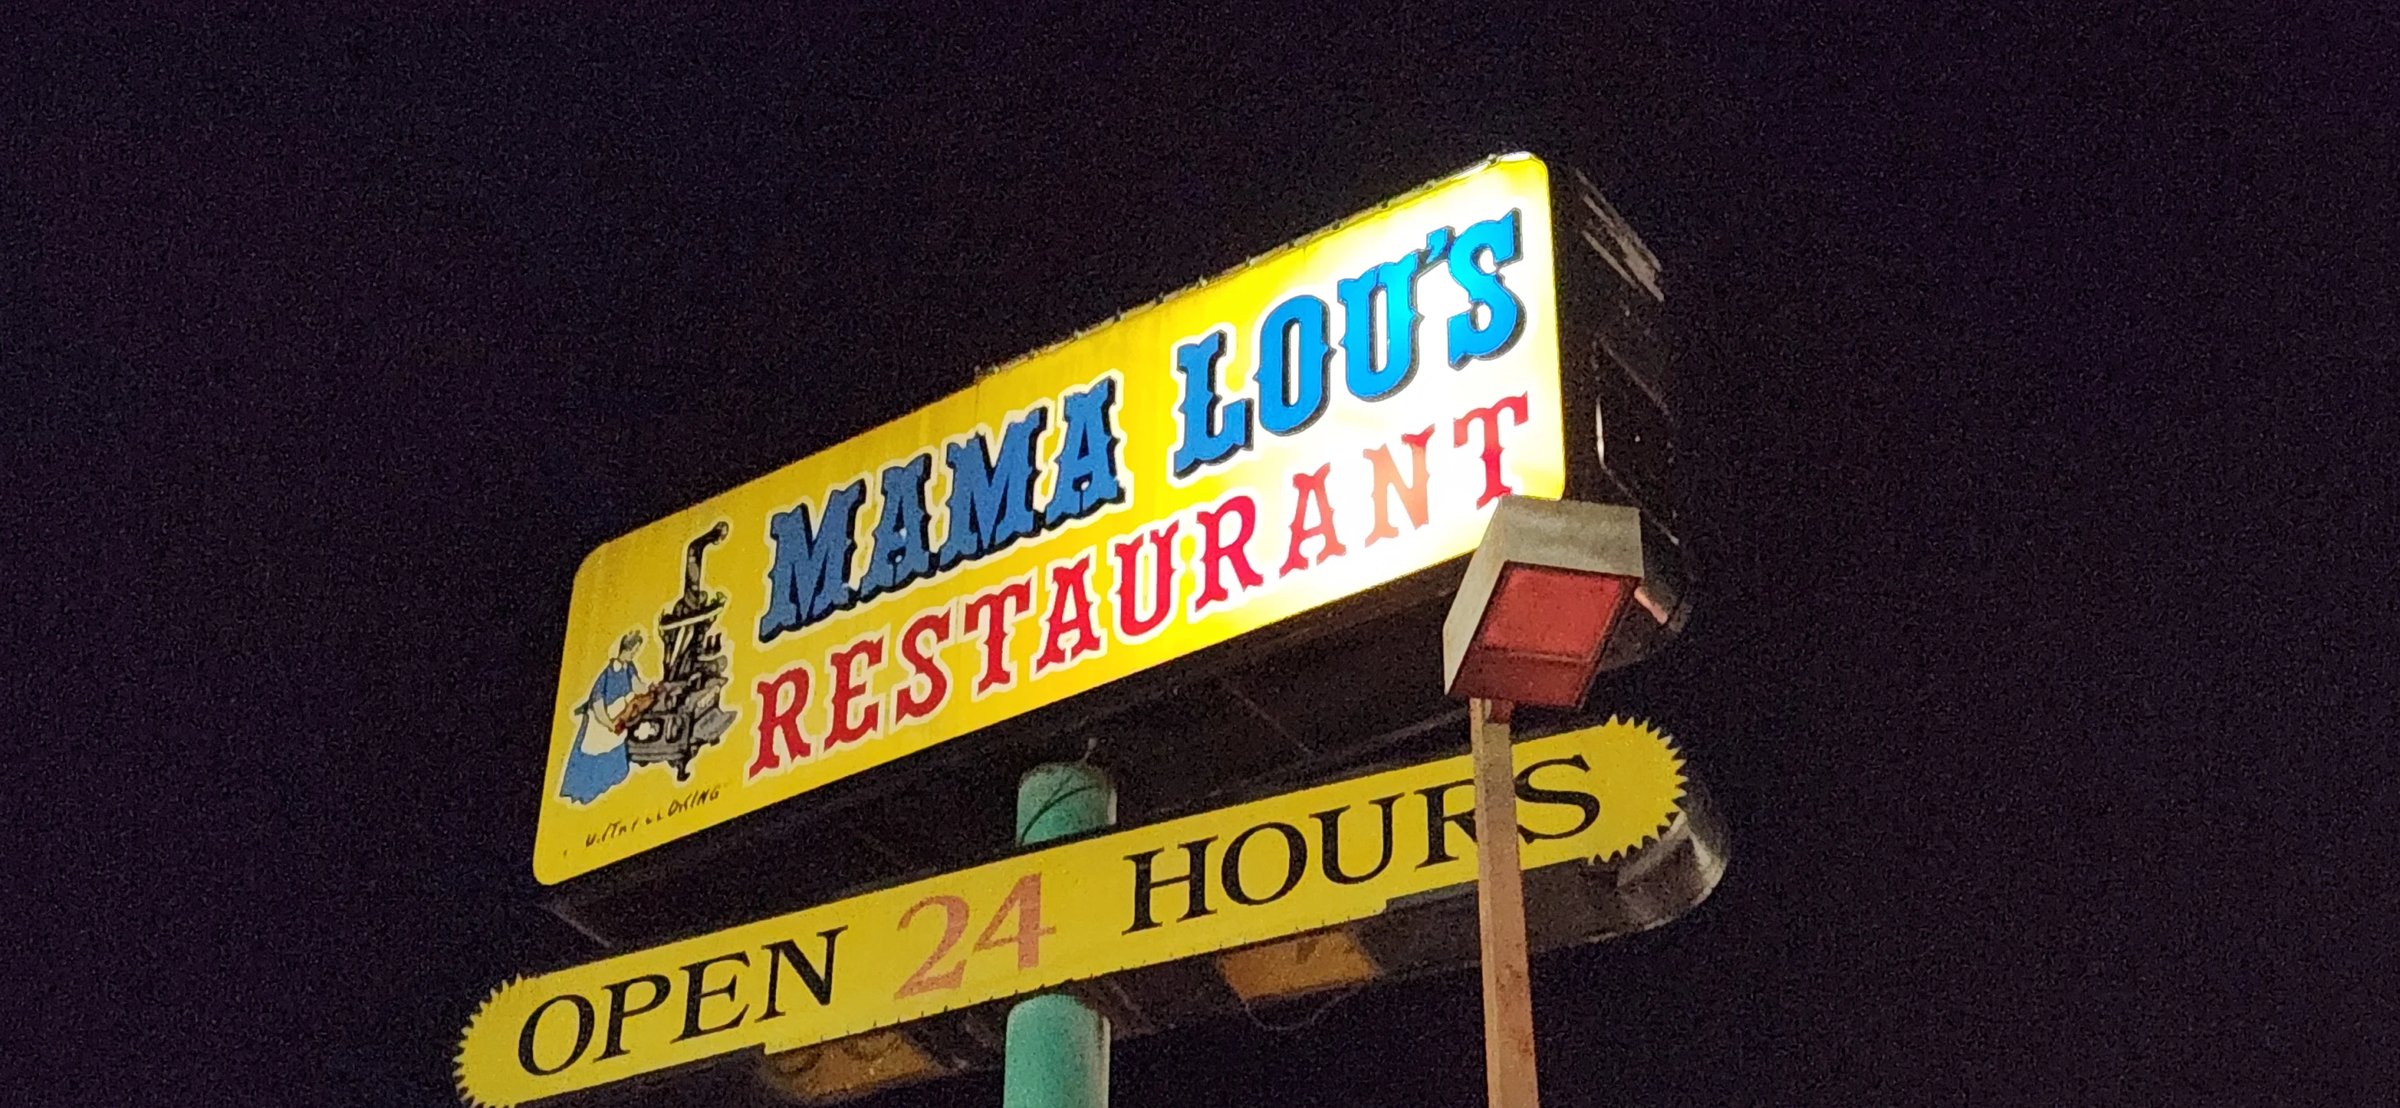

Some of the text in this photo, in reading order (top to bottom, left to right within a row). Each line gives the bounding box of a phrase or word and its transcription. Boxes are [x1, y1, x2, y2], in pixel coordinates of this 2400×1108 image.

[747, 390, 1530, 780] RESTAURANT
[758, 207, 1527, 644] MAMA LOU'S
[517, 753, 1601, 1077] OPEN 24 HOURS
